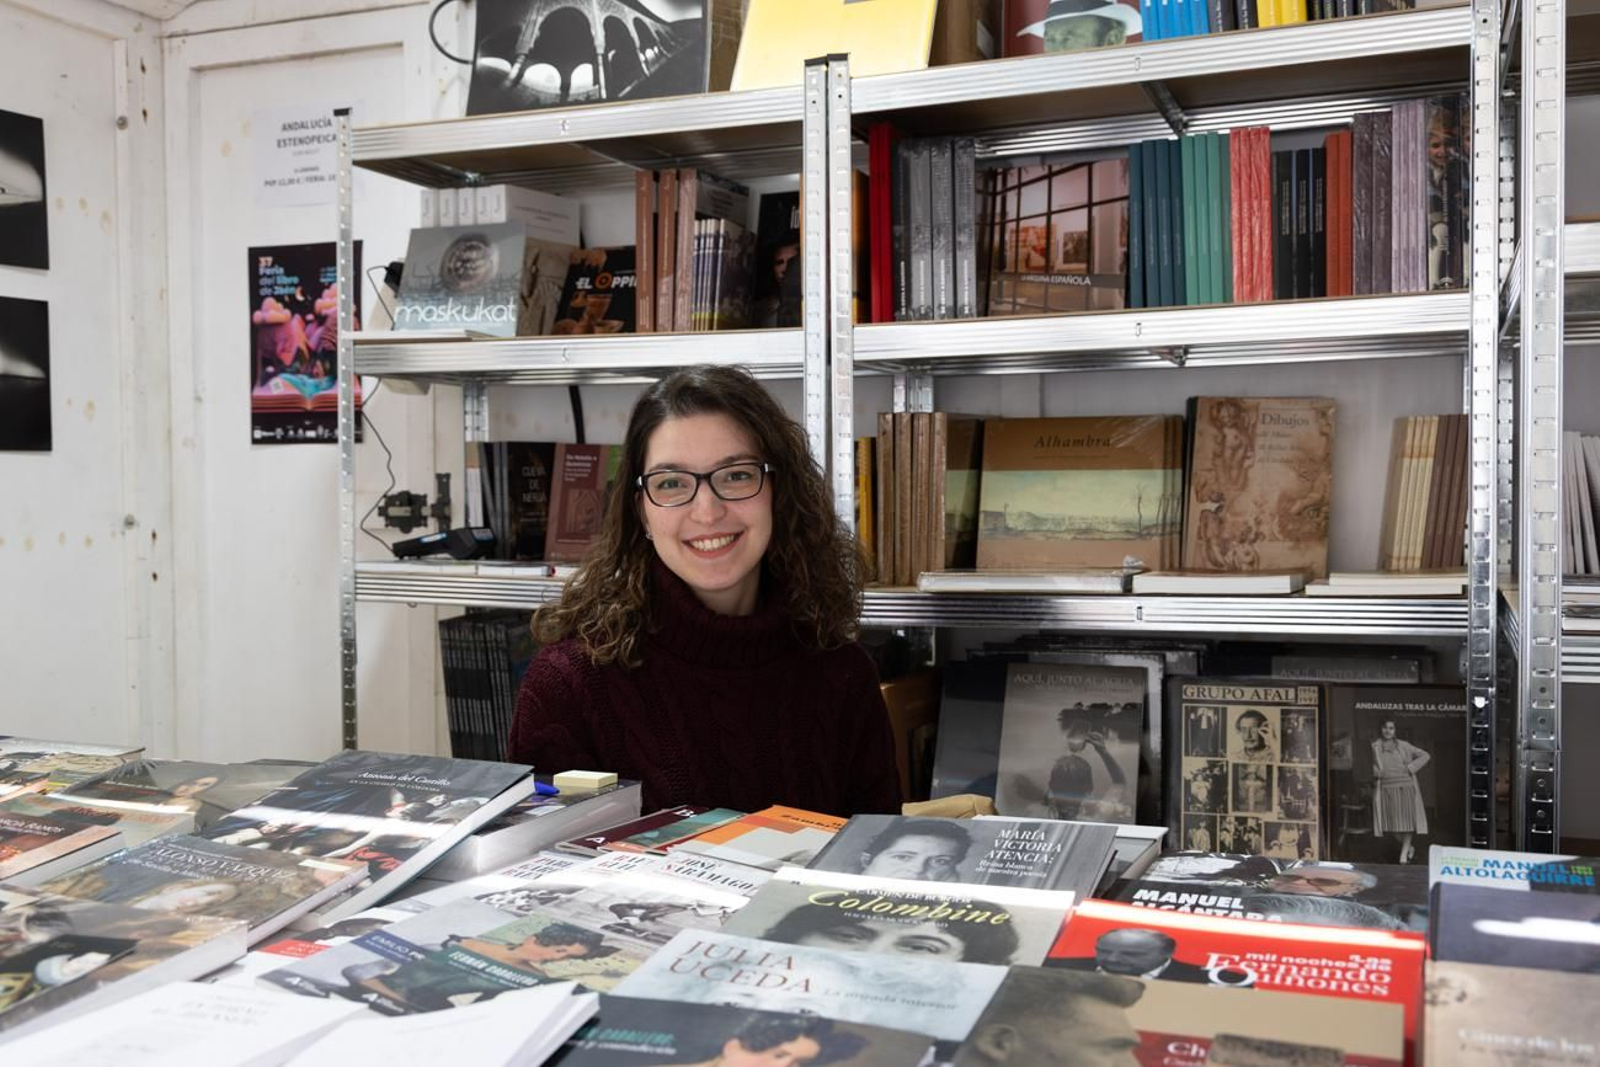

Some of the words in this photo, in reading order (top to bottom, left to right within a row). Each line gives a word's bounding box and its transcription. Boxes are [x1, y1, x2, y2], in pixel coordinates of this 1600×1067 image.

[281, 117, 332, 132] ANDALUCÍA
[277, 134, 337, 148] ESTENOPEICA
[575, 277, 594, 289] EL
[1051, 274, 1091, 286] ESPAÑOLA
[393, 296, 516, 324] maskukat
[1261, 412, 1310, 429] Dibujos
[1033, 434, 1111, 449] Alhambra
[1183, 685, 1245, 699] GRUPO
[1250, 688, 1293, 701] AFAL
[1355, 702, 1403, 710] ANDALUZAS
[1438, 702, 1468, 711] CÁMAR
[998, 828, 1045, 841] MARÍA
[994, 839, 1061, 853] VICTORIA
[984, 849, 1054, 864] ATENCIA:
[979, 860, 1004, 868] Reina
[1005, 861, 1034, 870] blanca
[987, 867, 1018, 875] nuestra
[1483, 858, 1569, 874] MANUEL
[1440, 866, 1596, 887] ALTOLAGUIRRE
[1132, 889, 1244, 909] MANUEL
[807, 889, 1012, 926] Colombine
[449, 950, 489, 969] FERNÁN
[684, 940, 794, 970] JULIA
[1245, 952, 1279, 962] mil
[1281, 955, 1360, 969] noches
[669, 957, 812, 993] UCEDA
[1201, 952, 1392, 984] Fernando
[1166, 1041, 1207, 1058] Ch
